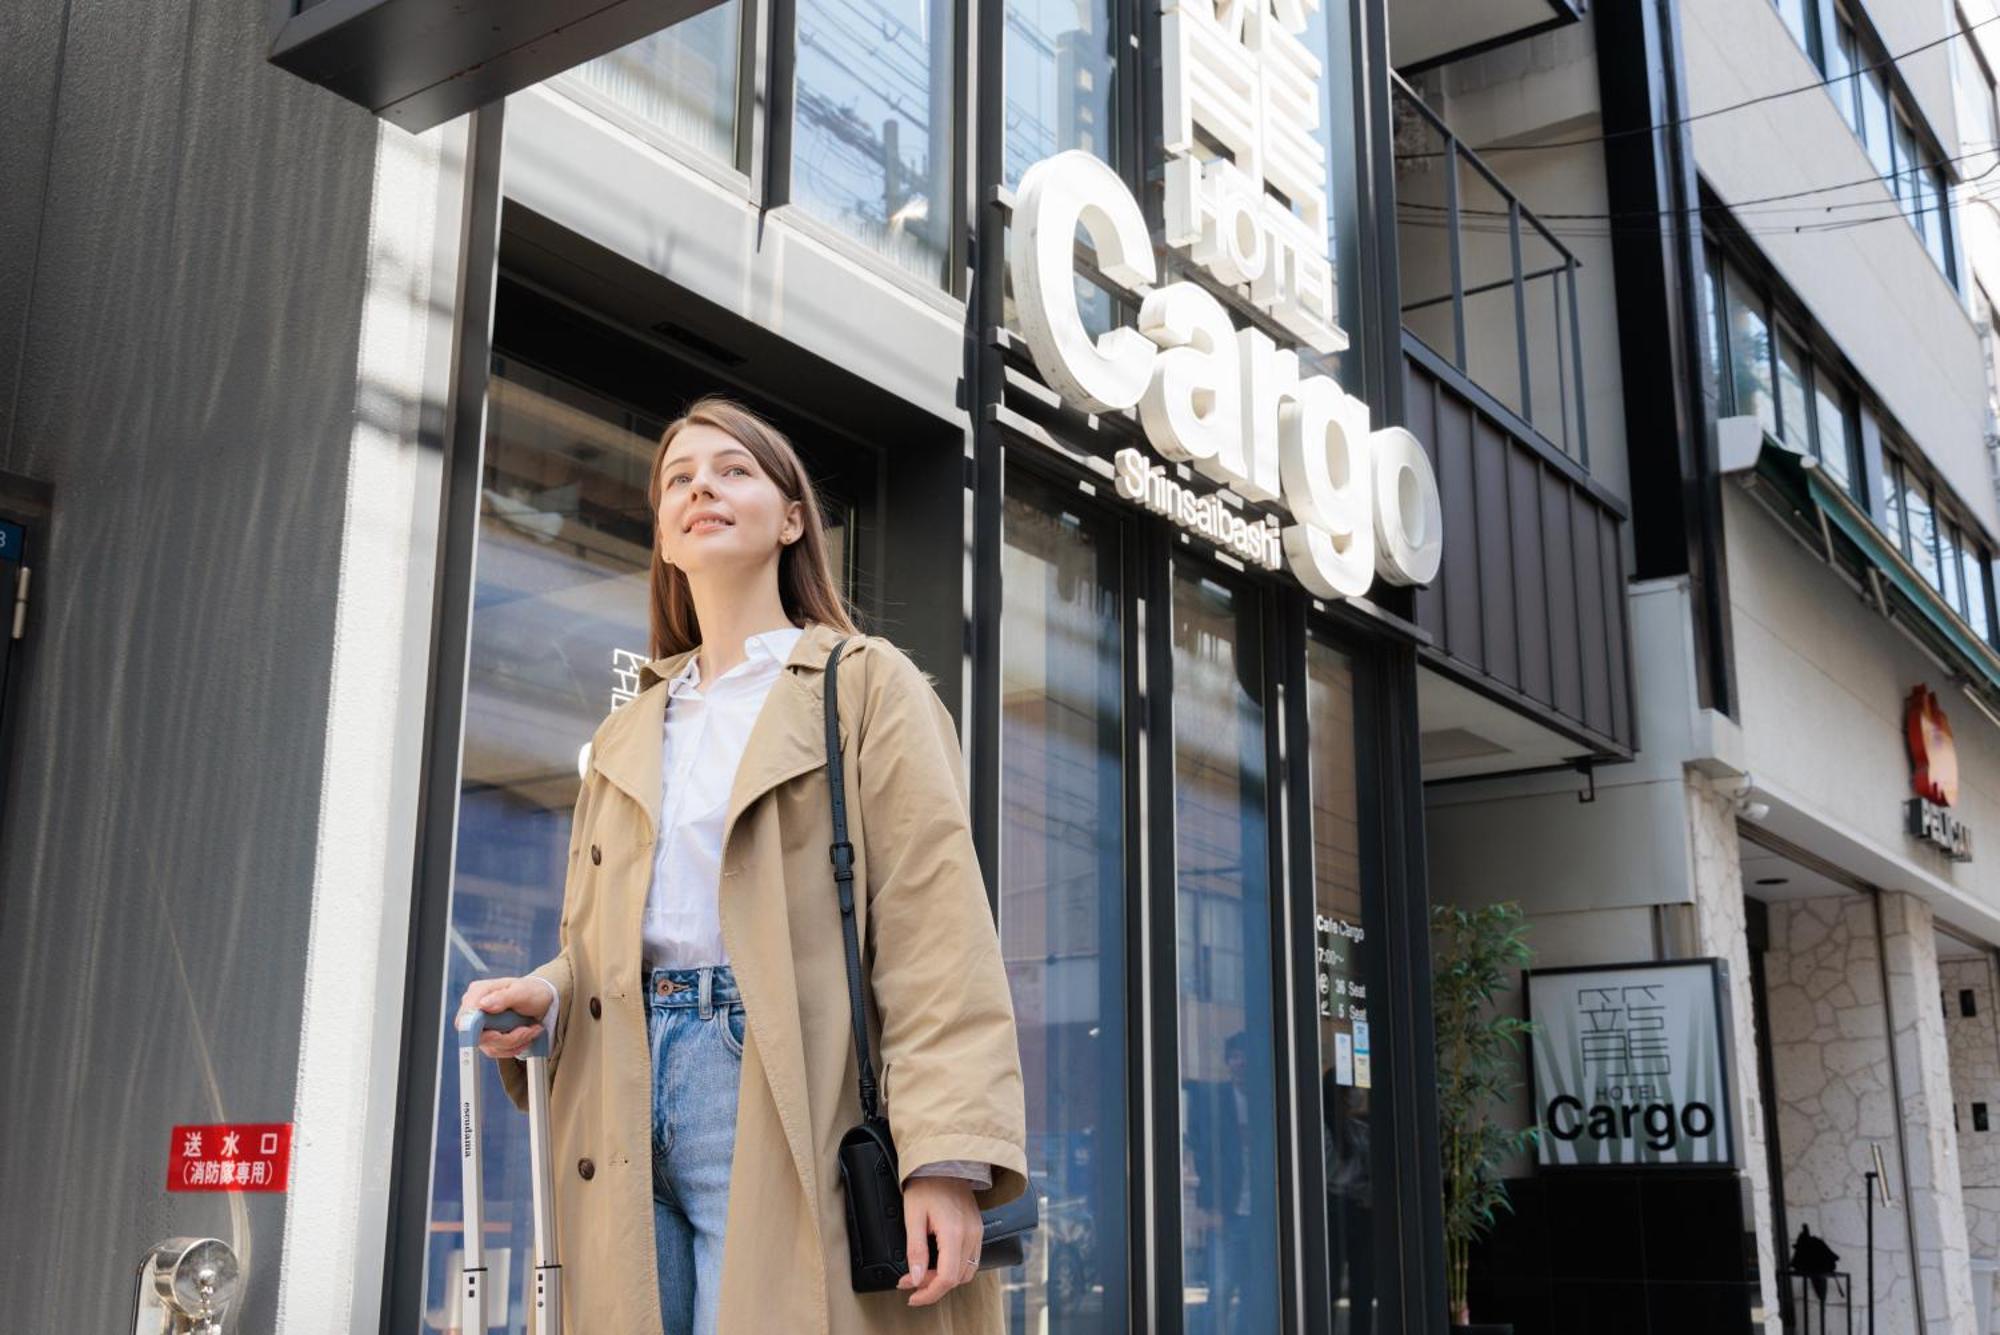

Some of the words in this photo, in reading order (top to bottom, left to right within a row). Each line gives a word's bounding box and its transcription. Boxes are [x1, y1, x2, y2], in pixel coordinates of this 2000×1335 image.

[1164, 152, 1350, 353] HOTEL
[1010, 149, 1443, 598] Cargo
[1115, 447, 1281, 570] Shinsaibashi
[1547, 1094, 1715, 1152] Cargo
[1596, 1084, 1663, 1101] HOTEL
